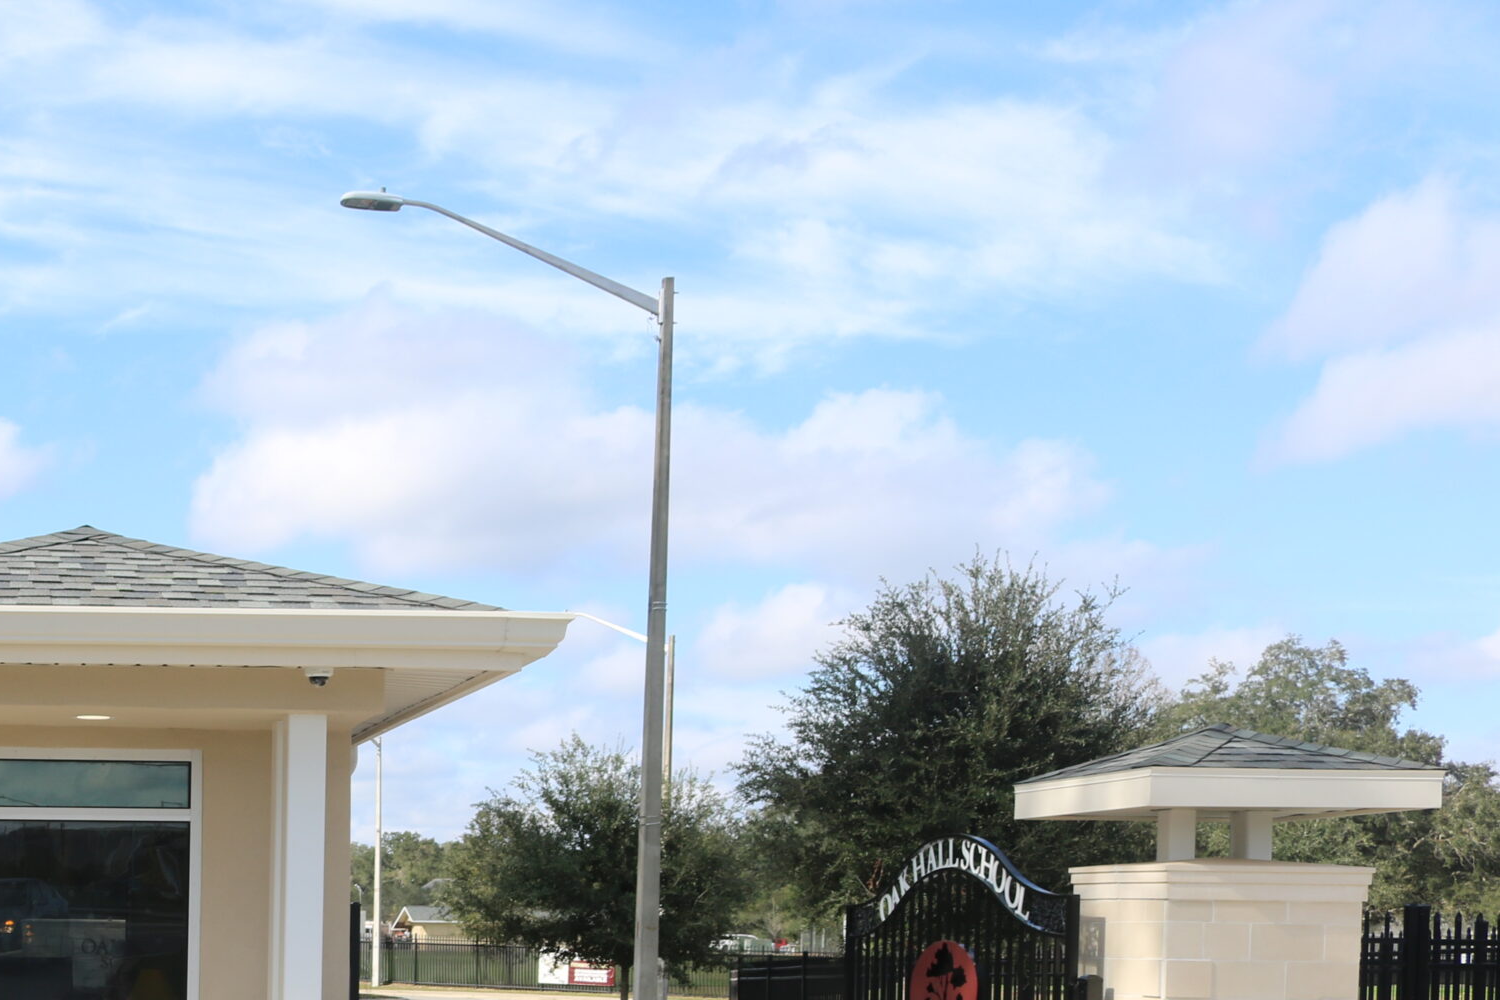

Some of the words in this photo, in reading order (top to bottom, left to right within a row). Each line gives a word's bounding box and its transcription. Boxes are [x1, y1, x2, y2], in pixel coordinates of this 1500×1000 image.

[879, 865, 911, 921] OAK
[911, 838, 960, 883] HALL
[960, 839, 1029, 921] SCHOOL
[81, 938, 115, 954] OA
